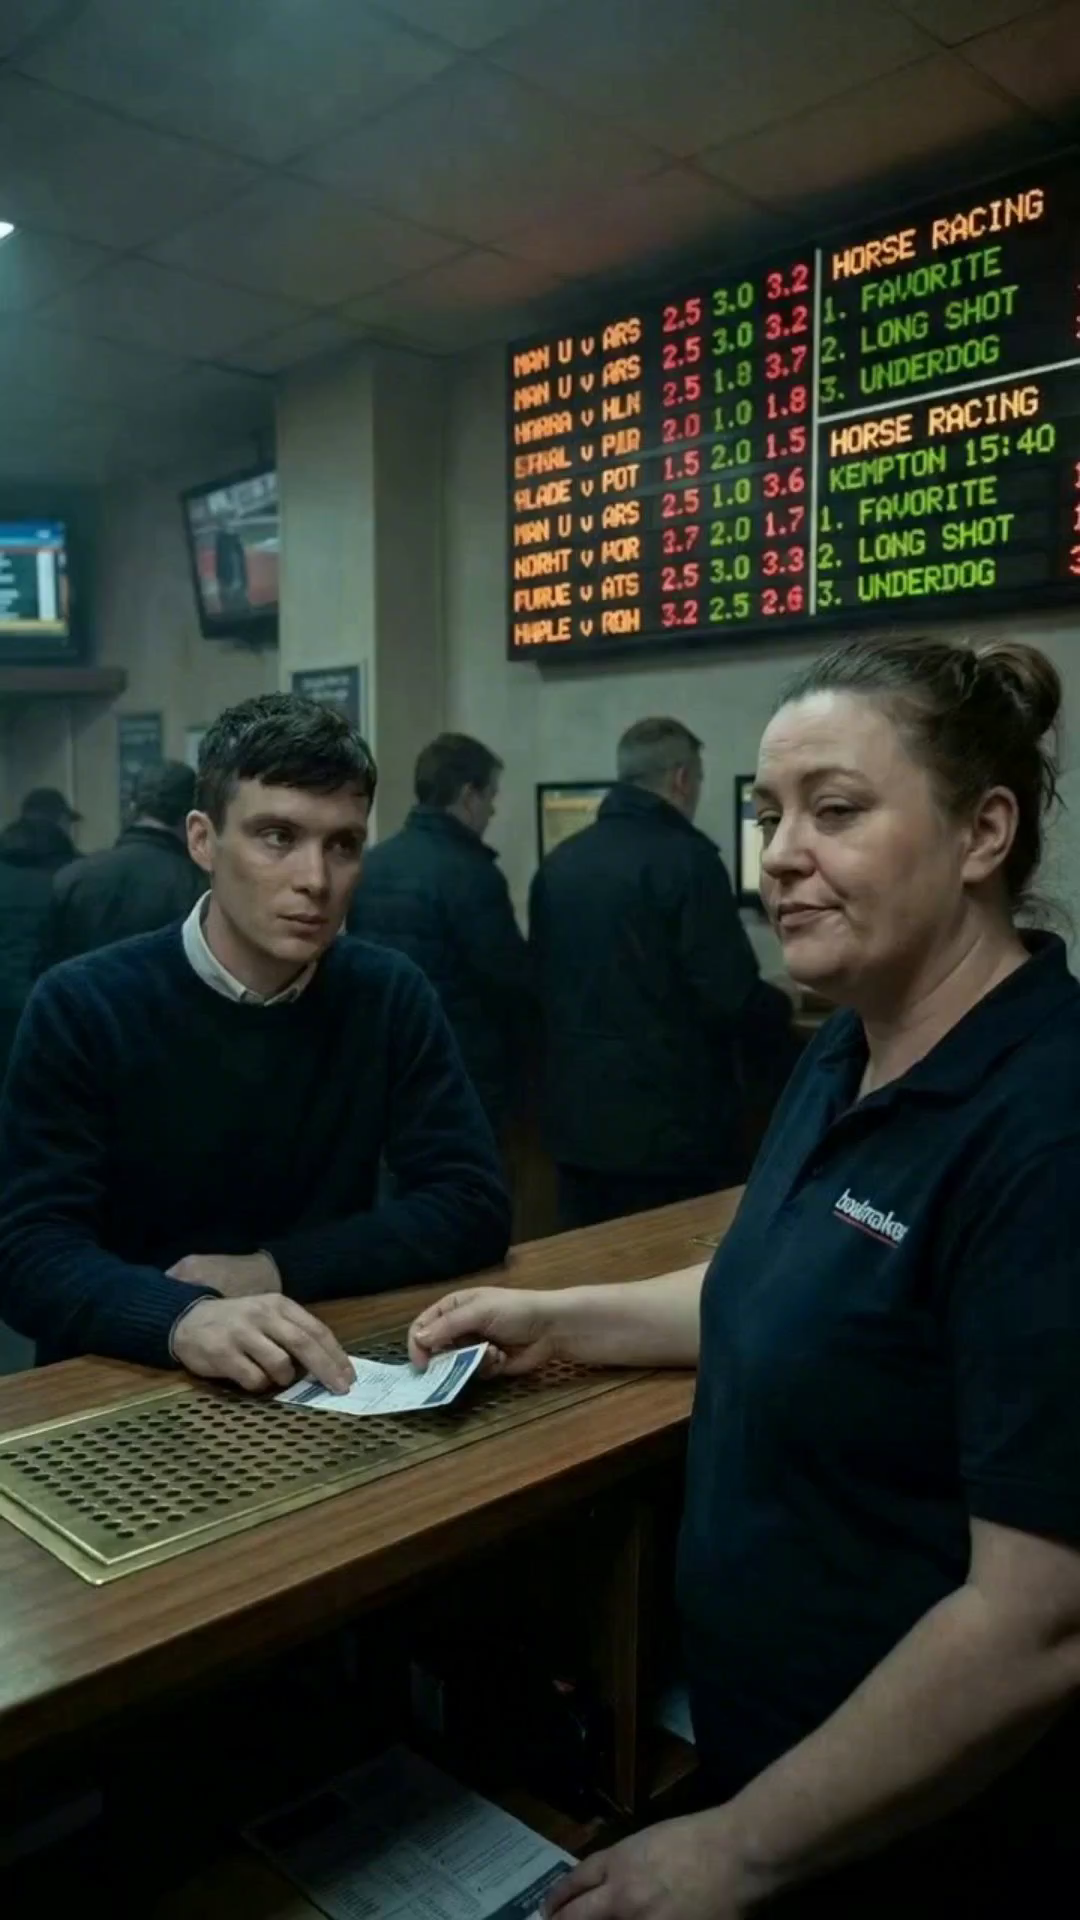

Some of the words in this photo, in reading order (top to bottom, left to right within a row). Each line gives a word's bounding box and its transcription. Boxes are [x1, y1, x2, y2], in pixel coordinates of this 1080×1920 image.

[832, 229, 916, 280] HORSE
[932, 188, 1044, 250] RACING
[558, 338, 572, 364] U
[603, 318, 641, 350] ARS
[663, 299, 700, 332] 2.5
[712, 282, 754, 316] 3.0
[767, 264, 808, 298] 3.2
[824, 297, 846, 324] 1.
[862, 247, 1002, 312] FAVORITE
[558, 374, 572, 398] U
[602, 355, 641, 387] ARS
[663, 337, 700, 370] 2.5
[712, 322, 753, 355] 3.0
[766, 306, 808, 340] 3.2
[821, 337, 845, 364] 2.
[861, 312, 928, 354] LONG
[945, 285, 1019, 330] SHOT
[663, 375, 700, 407] 2.5
[713, 361, 752, 393] 1.8
[766, 346, 807, 379] 3.7
[820, 376, 844, 403] 3.
[860, 336, 1000, 394] UNDERDOG
[663, 414, 700, 444] 2.0
[714, 400, 752, 432] 1.0
[767, 386, 806, 418] 1.8
[830, 414, 913, 457] HORSE
[928, 386, 1038, 436] RACING
[602, 464, 640, 494] POT
[664, 450, 699, 480] 1.5
[711, 438, 750, 470] 2.0
[766, 426, 806, 458] 1.5
[830, 446, 946, 492] KEMPTON
[966, 424, 1056, 466] 15:40
[558, 513, 572, 538] U
[602, 500, 640, 530] ARS
[662, 488, 699, 518] 2.5
[713, 478, 750, 508] 1.0
[764, 467, 804, 498] 3.6
[662, 526, 699, 554] 3.7
[711, 517, 750, 546] 2.0
[766, 506, 804, 536] 1.7
[820, 506, 842, 532] 1.
[860, 476, 997, 525] FAVORITE
[602, 572, 640, 600] ATS
[661, 563, 698, 592] 2.5
[710, 555, 750, 584] 3.0
[763, 546, 804, 575] 3.3
[818, 544, 842, 568] 2.
[859, 529, 926, 563] LONG
[942, 514, 1014, 550] SHOT
[661, 600, 698, 626] 3.2
[710, 592, 750, 622] 2.5
[762, 586, 804, 615] 2.6
[818, 580, 842, 607] 3.
[858, 558, 995, 601] UNDERDOG
